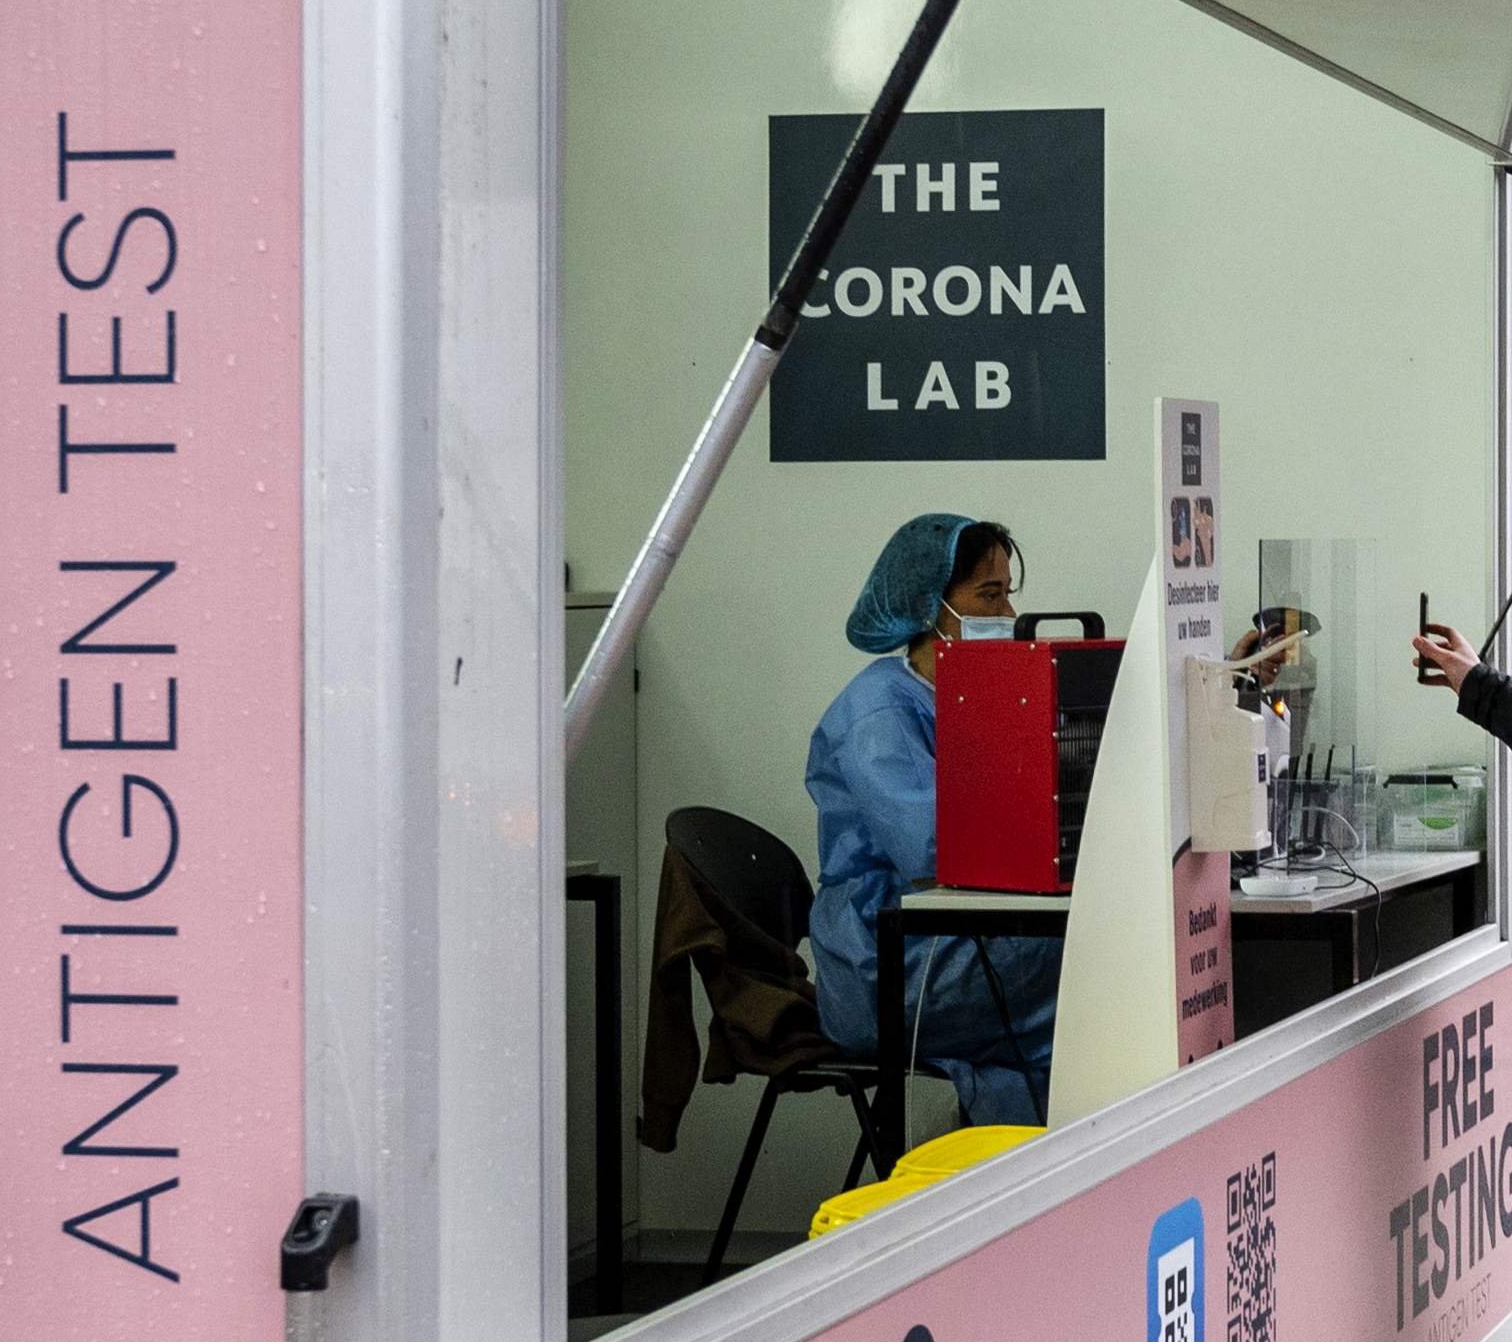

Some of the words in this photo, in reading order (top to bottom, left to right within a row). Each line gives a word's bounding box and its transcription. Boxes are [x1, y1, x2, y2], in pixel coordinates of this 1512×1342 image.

[872, 161, 1002, 213] THE
[55, 111, 179, 494] TEST
[798, 263, 1087, 319] CORONA
[866, 359, 1013, 412] LAB
[1167, 581, 1206, 607] Desinfecteer
[1206, 582, 1220, 604] hier
[1187, 616, 1212, 640] handen
[58, 560, 180, 1285] ANTIGEN
[1188, 902, 1218, 938] Bedankt
[1190, 949, 1207, 977] voor
[1181, 979, 1228, 1022] medewerking
[1422, 1000, 1495, 1161] FREE
[1469, 1272, 1493, 1324] TEST
